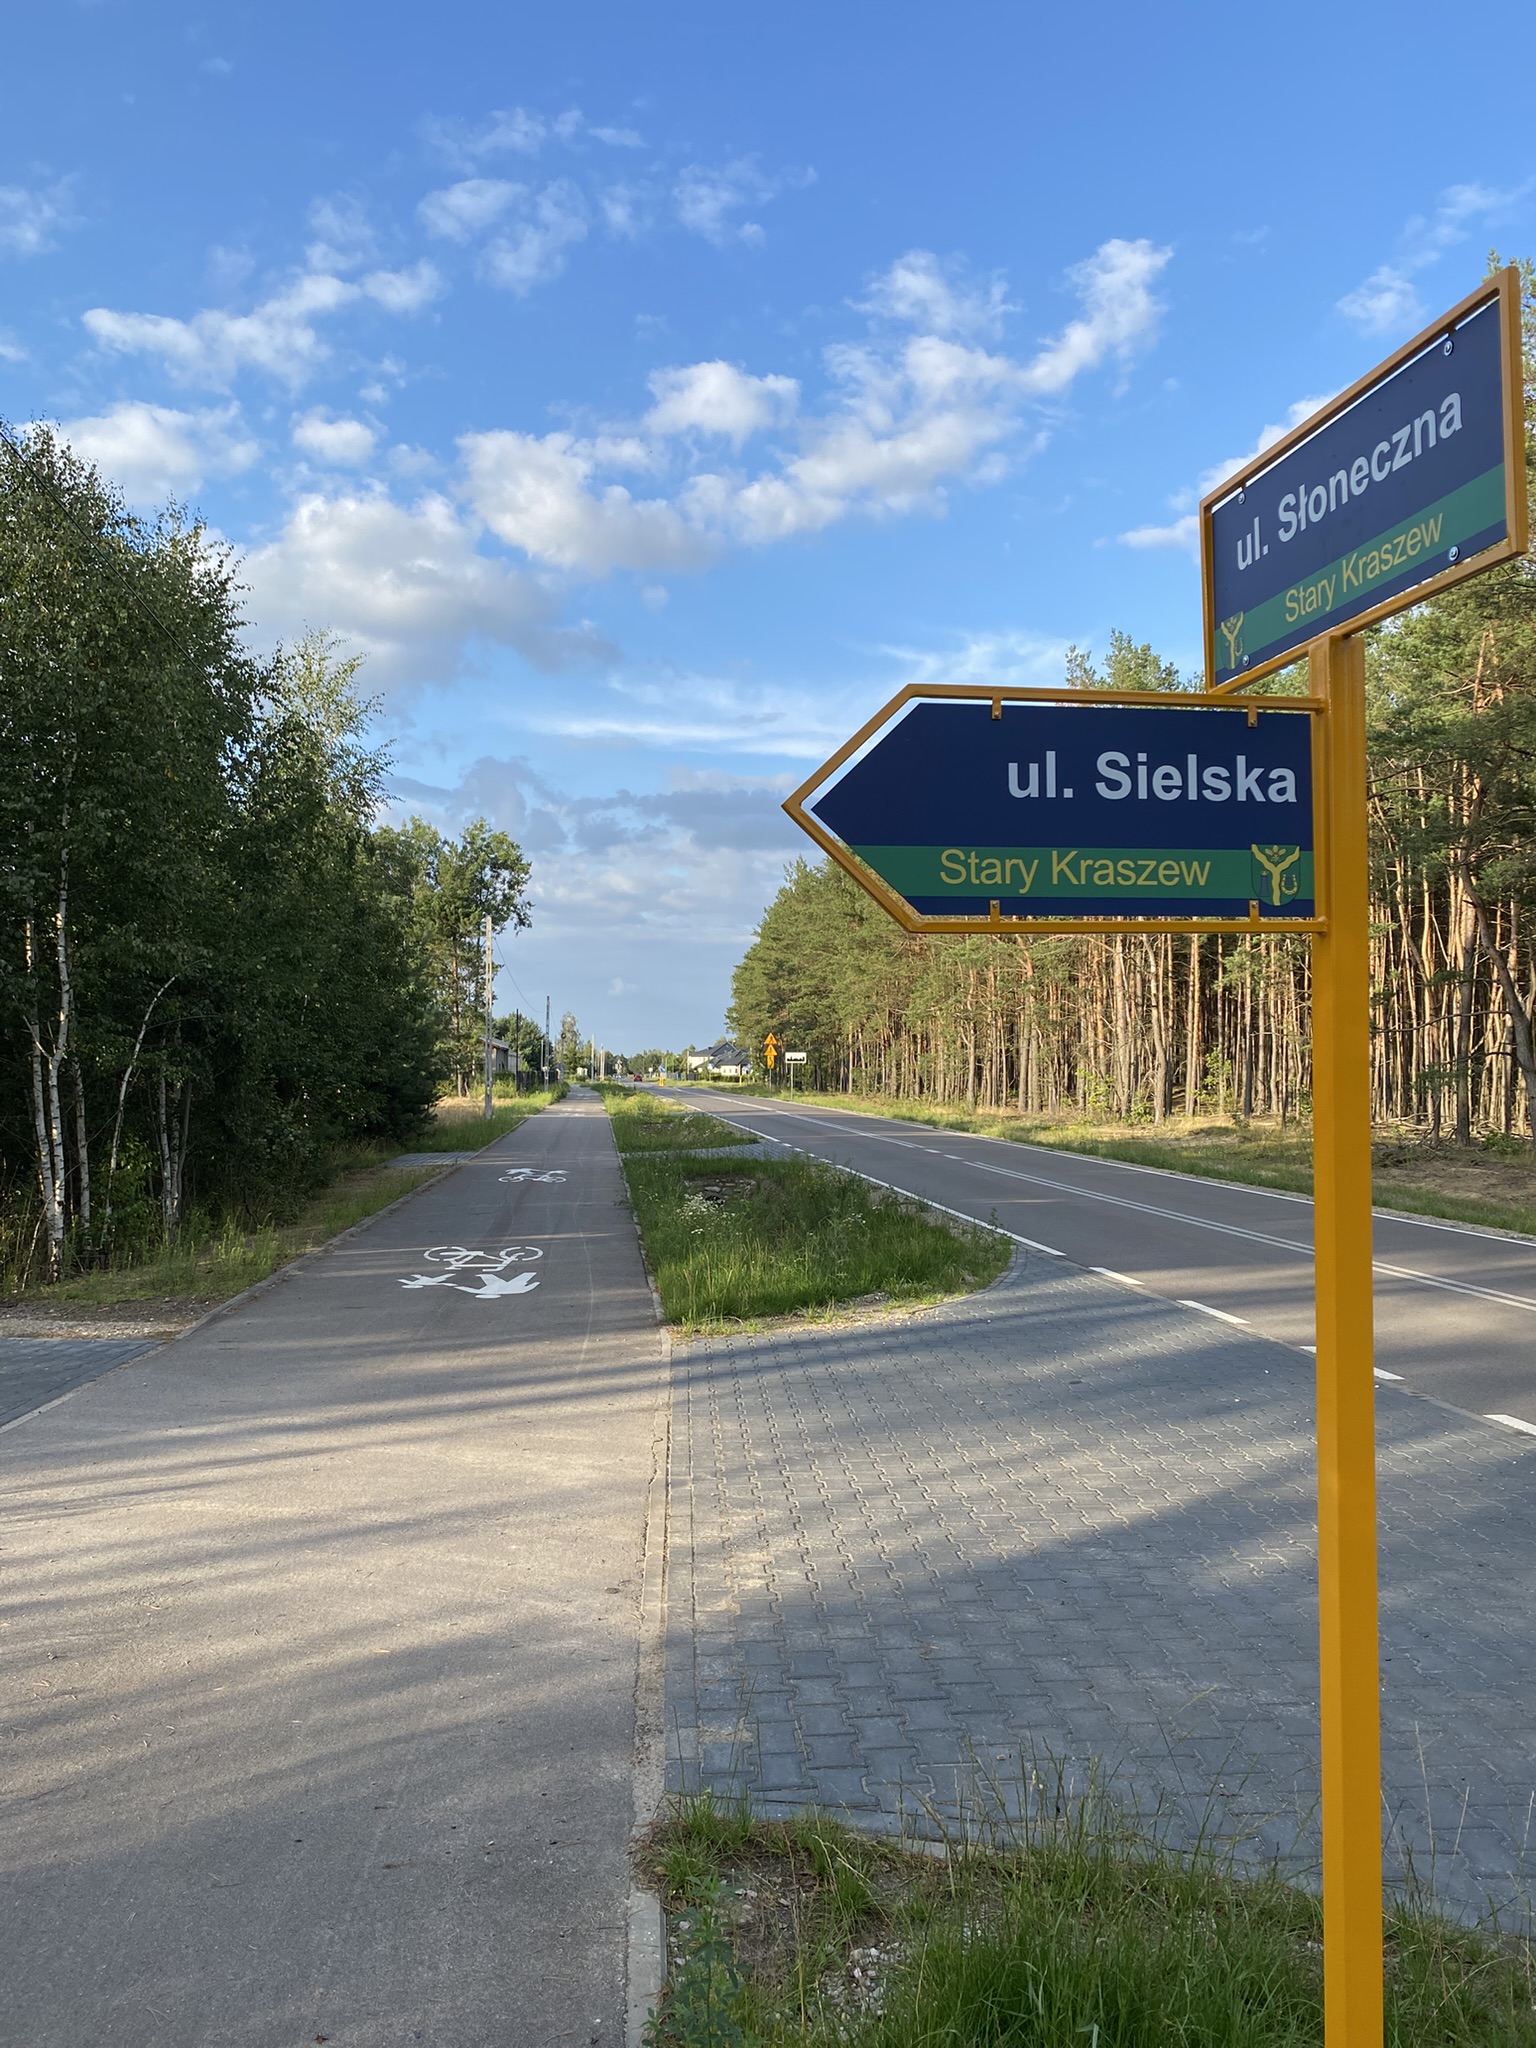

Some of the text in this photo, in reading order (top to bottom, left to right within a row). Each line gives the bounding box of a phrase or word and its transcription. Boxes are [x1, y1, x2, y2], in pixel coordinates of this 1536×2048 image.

[1236, 391, 1463, 571] ul. Słoneczna
[1285, 513, 1443, 622] Stary Kraszew
[1008, 751, 1298, 803] ul. Sielska
[940, 849, 1211, 894] Stary Kraszew
